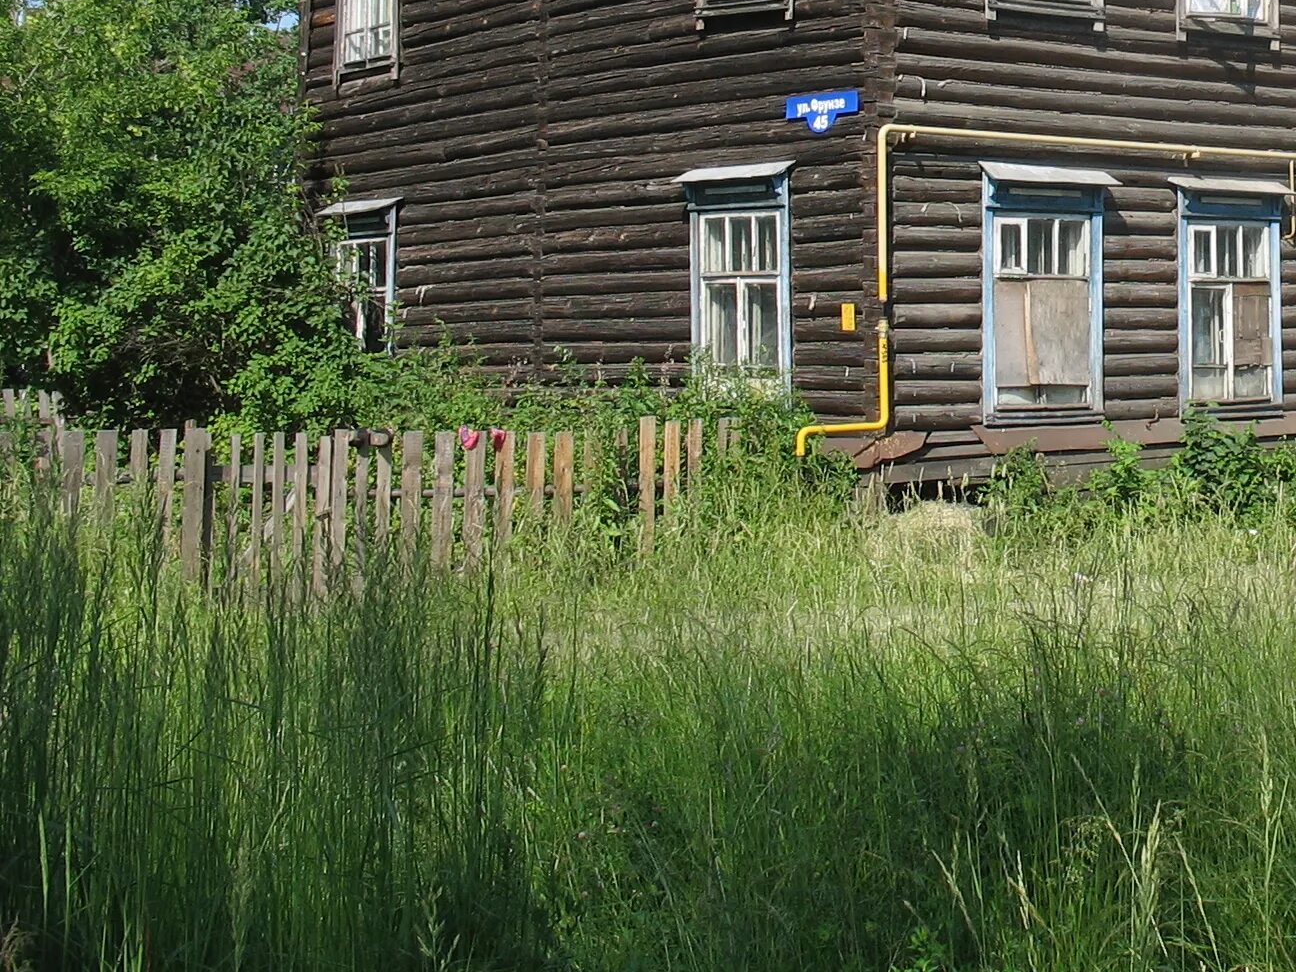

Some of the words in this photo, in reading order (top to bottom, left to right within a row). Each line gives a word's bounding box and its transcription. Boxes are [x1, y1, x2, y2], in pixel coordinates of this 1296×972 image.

[796, 103, 811, 117] ул.
[810, 98, 845, 114] Фрунзе
[813, 115, 828, 130] 45
